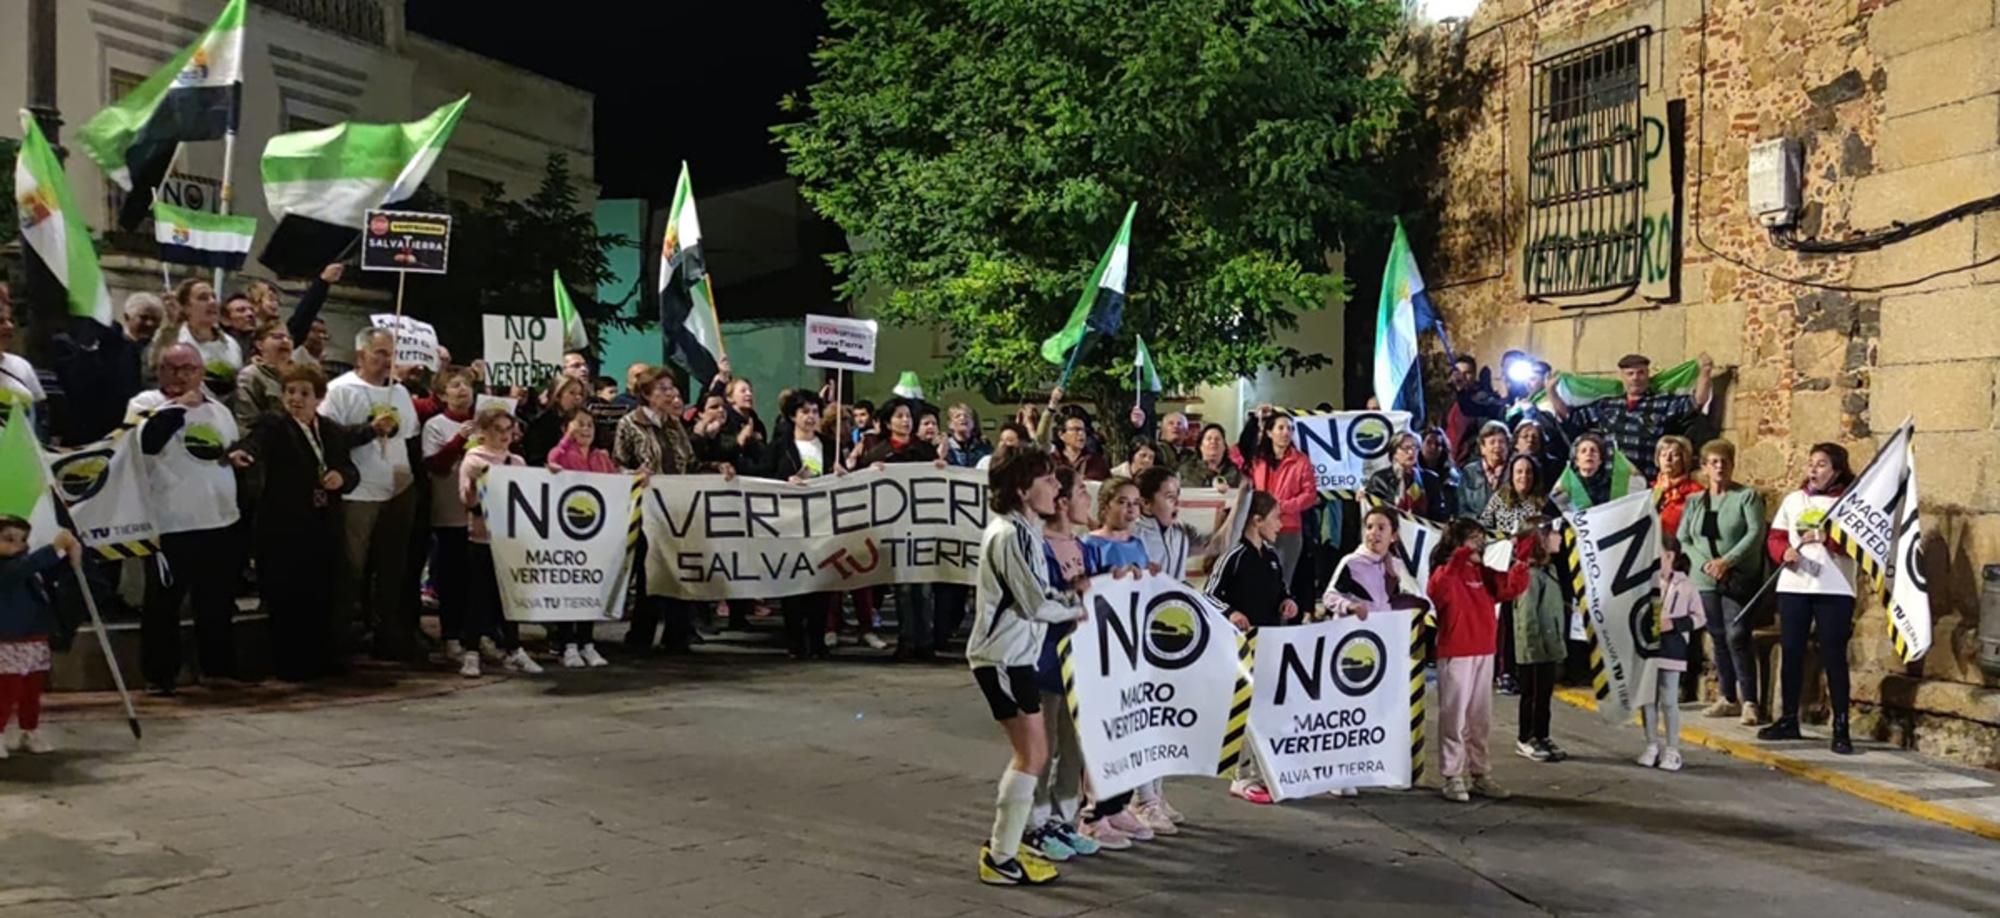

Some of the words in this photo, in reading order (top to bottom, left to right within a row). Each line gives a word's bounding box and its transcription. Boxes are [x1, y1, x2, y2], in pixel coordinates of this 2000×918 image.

[1531, 117, 1664, 209] STOP
[369, 234, 443, 251] SALVATIERRA
[505, 314, 546, 341] NO
[511, 341, 541, 364] AL
[1296, 411, 1394, 462] NO
[508, 480, 606, 541] NO
[88, 527, 110, 539] TU
[525, 550, 588, 566] MACRO
[677, 551, 815, 583] SALVA
[817, 537, 879, 580] TU
[510, 568, 604, 585] VERTEDERO
[543, 598, 561, 609] TU
[563, 597, 602, 609] TIERRA
[1093, 590, 1211, 677] NO
[1273, 629, 1387, 705] NO
[1120, 681, 1175, 711] MACRO
[1101, 706, 1198, 741] VERTEDERO
[1294, 707, 1367, 734] MACRO
[1270, 726, 1386, 755] VERTEDERO
[1129, 750, 1143, 769] TU
[1280, 769, 1312, 785] ALVA
[1313, 765, 1333, 780] TU
[1338, 759, 1385, 778] TIERRA
